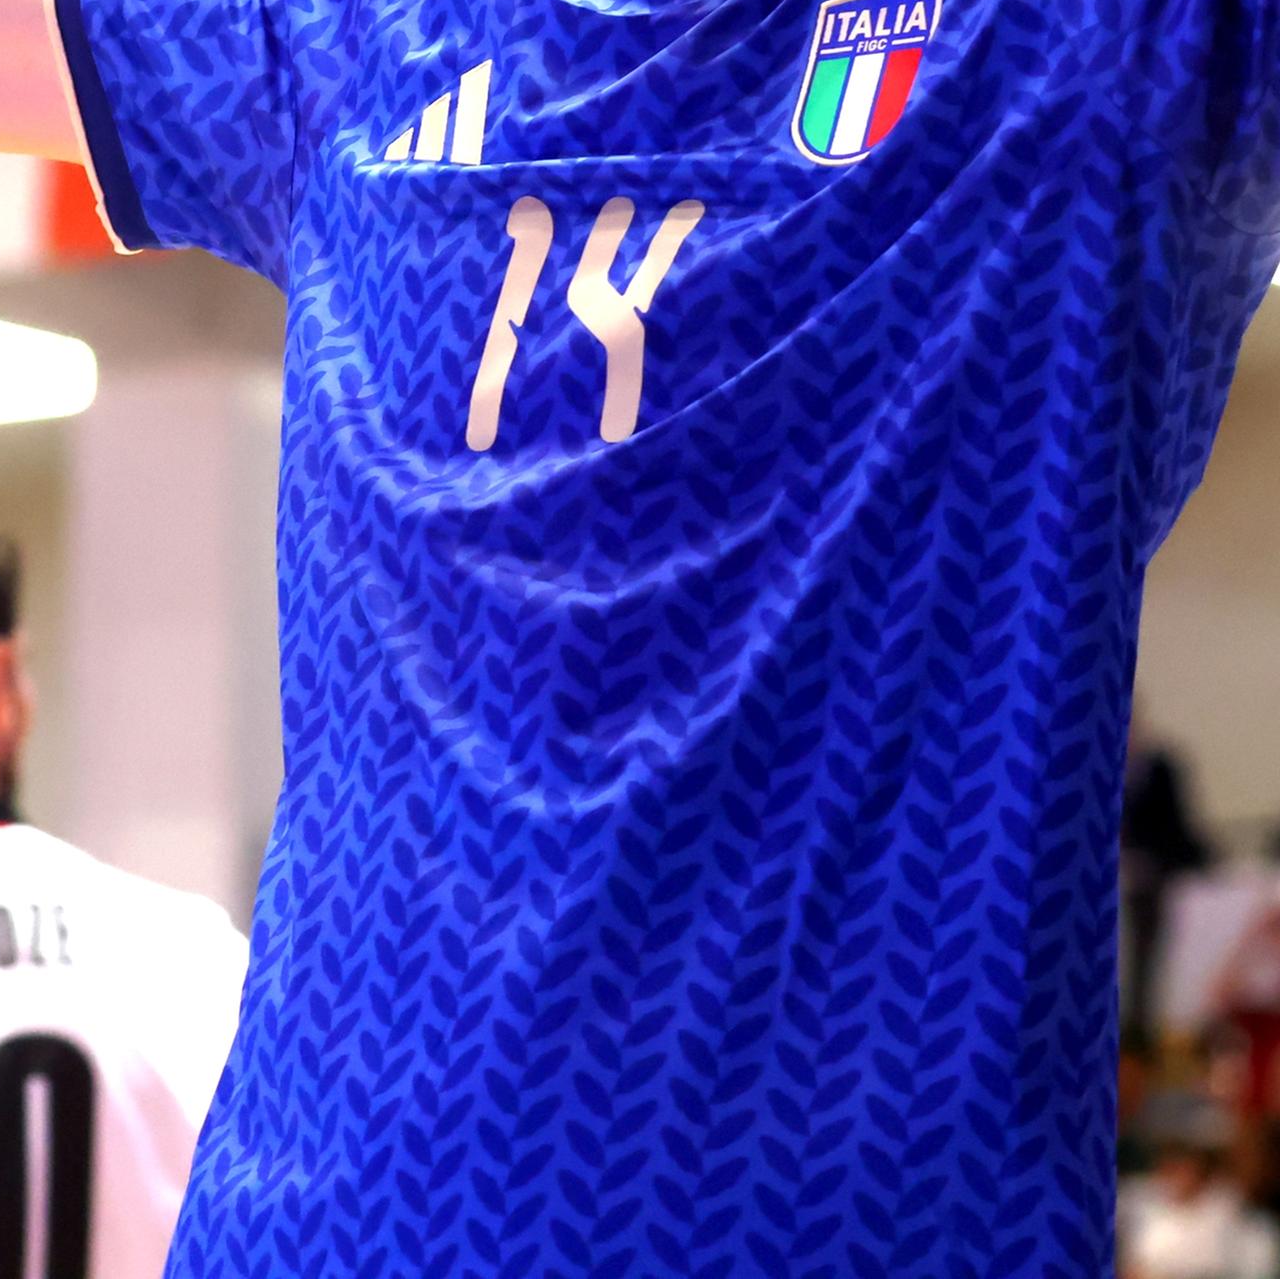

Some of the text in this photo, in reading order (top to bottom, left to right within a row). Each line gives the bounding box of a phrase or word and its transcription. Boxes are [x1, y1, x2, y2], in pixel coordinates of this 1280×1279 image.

[822, 1, 928, 44] ITALIA
[856, 39, 888, 53] FIGC
[465, 195, 706, 452] 14
